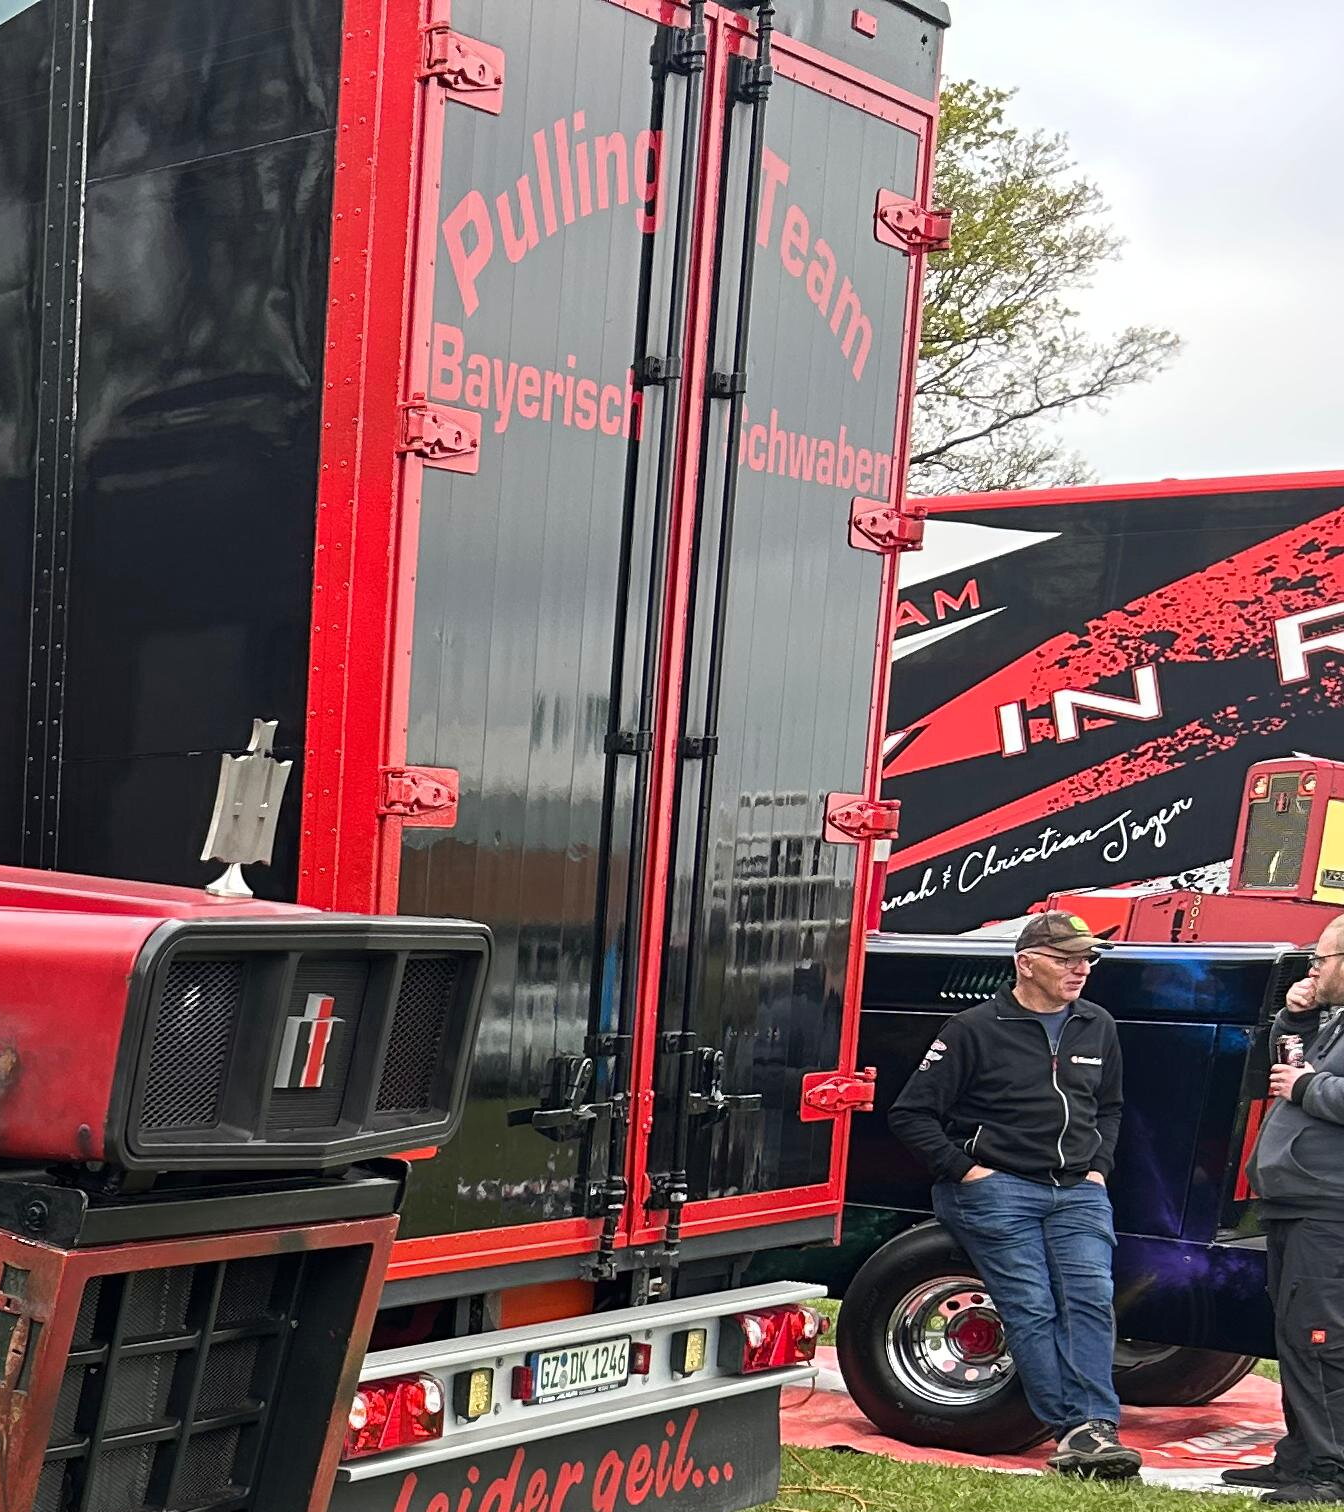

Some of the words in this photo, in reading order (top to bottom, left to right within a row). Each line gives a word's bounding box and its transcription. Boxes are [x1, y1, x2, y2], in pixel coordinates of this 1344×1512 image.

[441, 110, 666, 318] Pulling
[756, 145, 873, 382] Team
[431, 322, 645, 441] Bayerisch
[896, 578, 981, 628] AM
[1272, 601, 1344, 686] R
[958, 827, 1101, 893] Christian
[540, 1355, 560, 1390] GZ
[569, 1350, 588, 1385] DK
[591, 1343, 626, 1381] 1246
